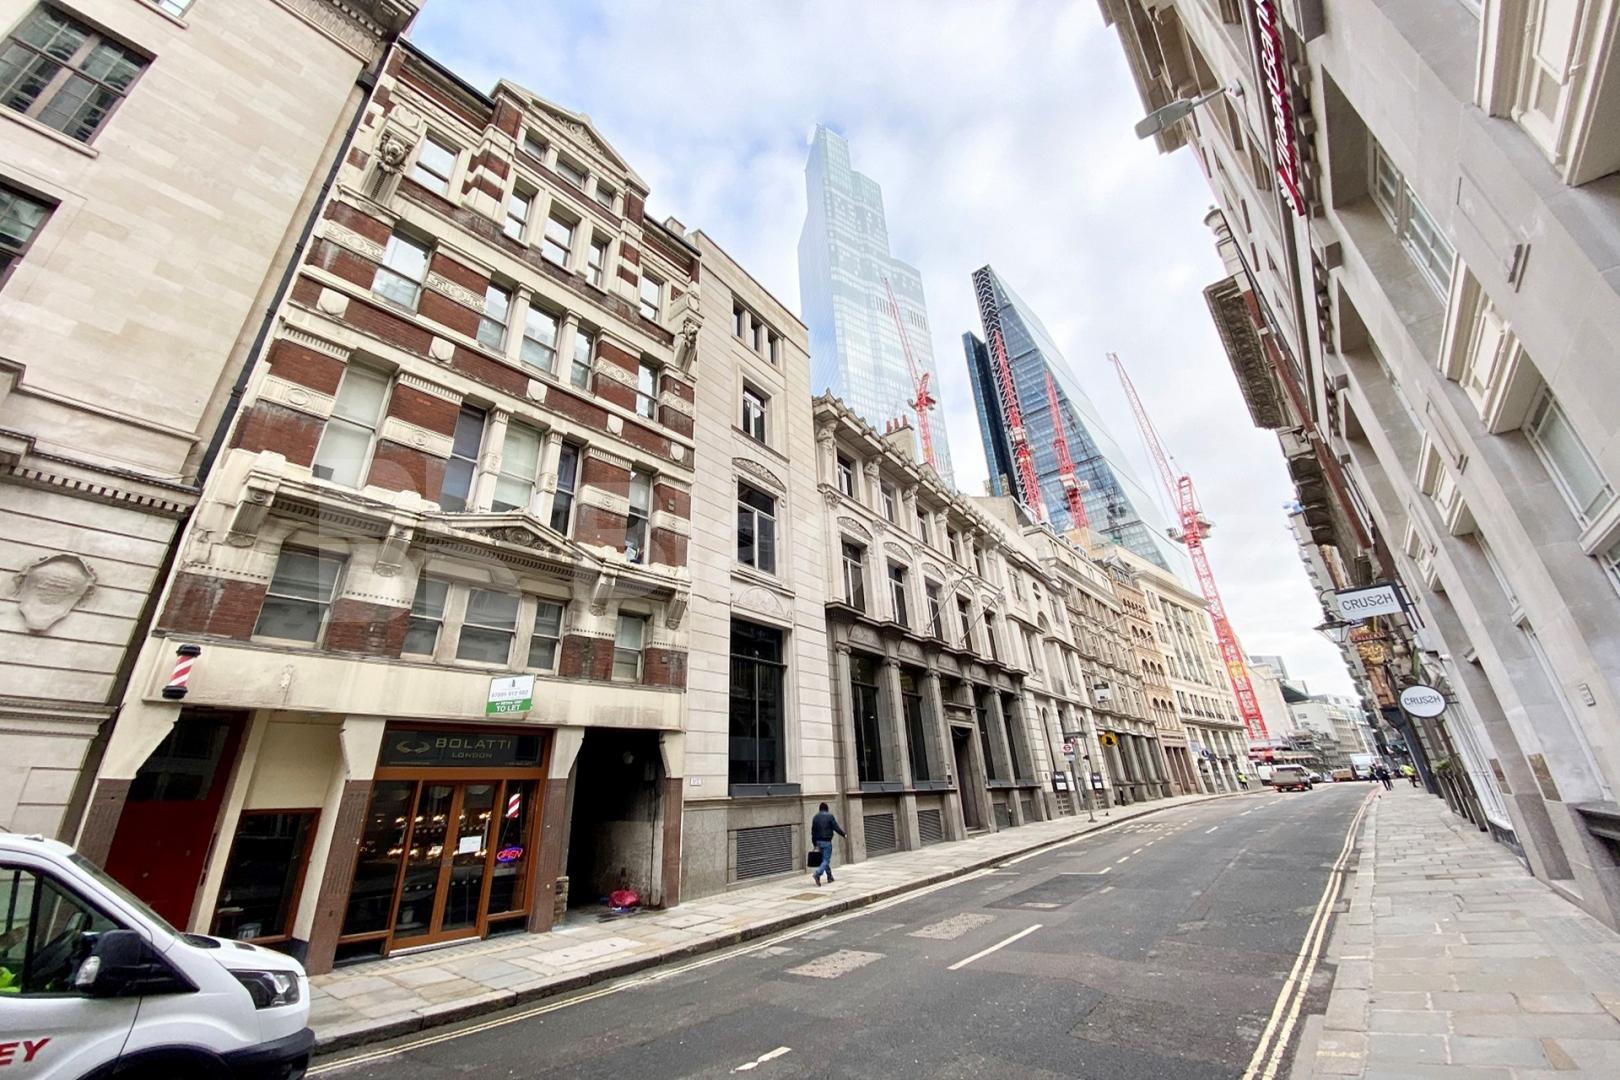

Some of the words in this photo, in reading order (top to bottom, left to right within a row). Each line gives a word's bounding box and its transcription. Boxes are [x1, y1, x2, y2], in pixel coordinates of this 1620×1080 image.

[435, 737, 512, 751] BOLATTI
[451, 752, 493, 760] LONDON
[496, 848, 523, 860] OPEN
